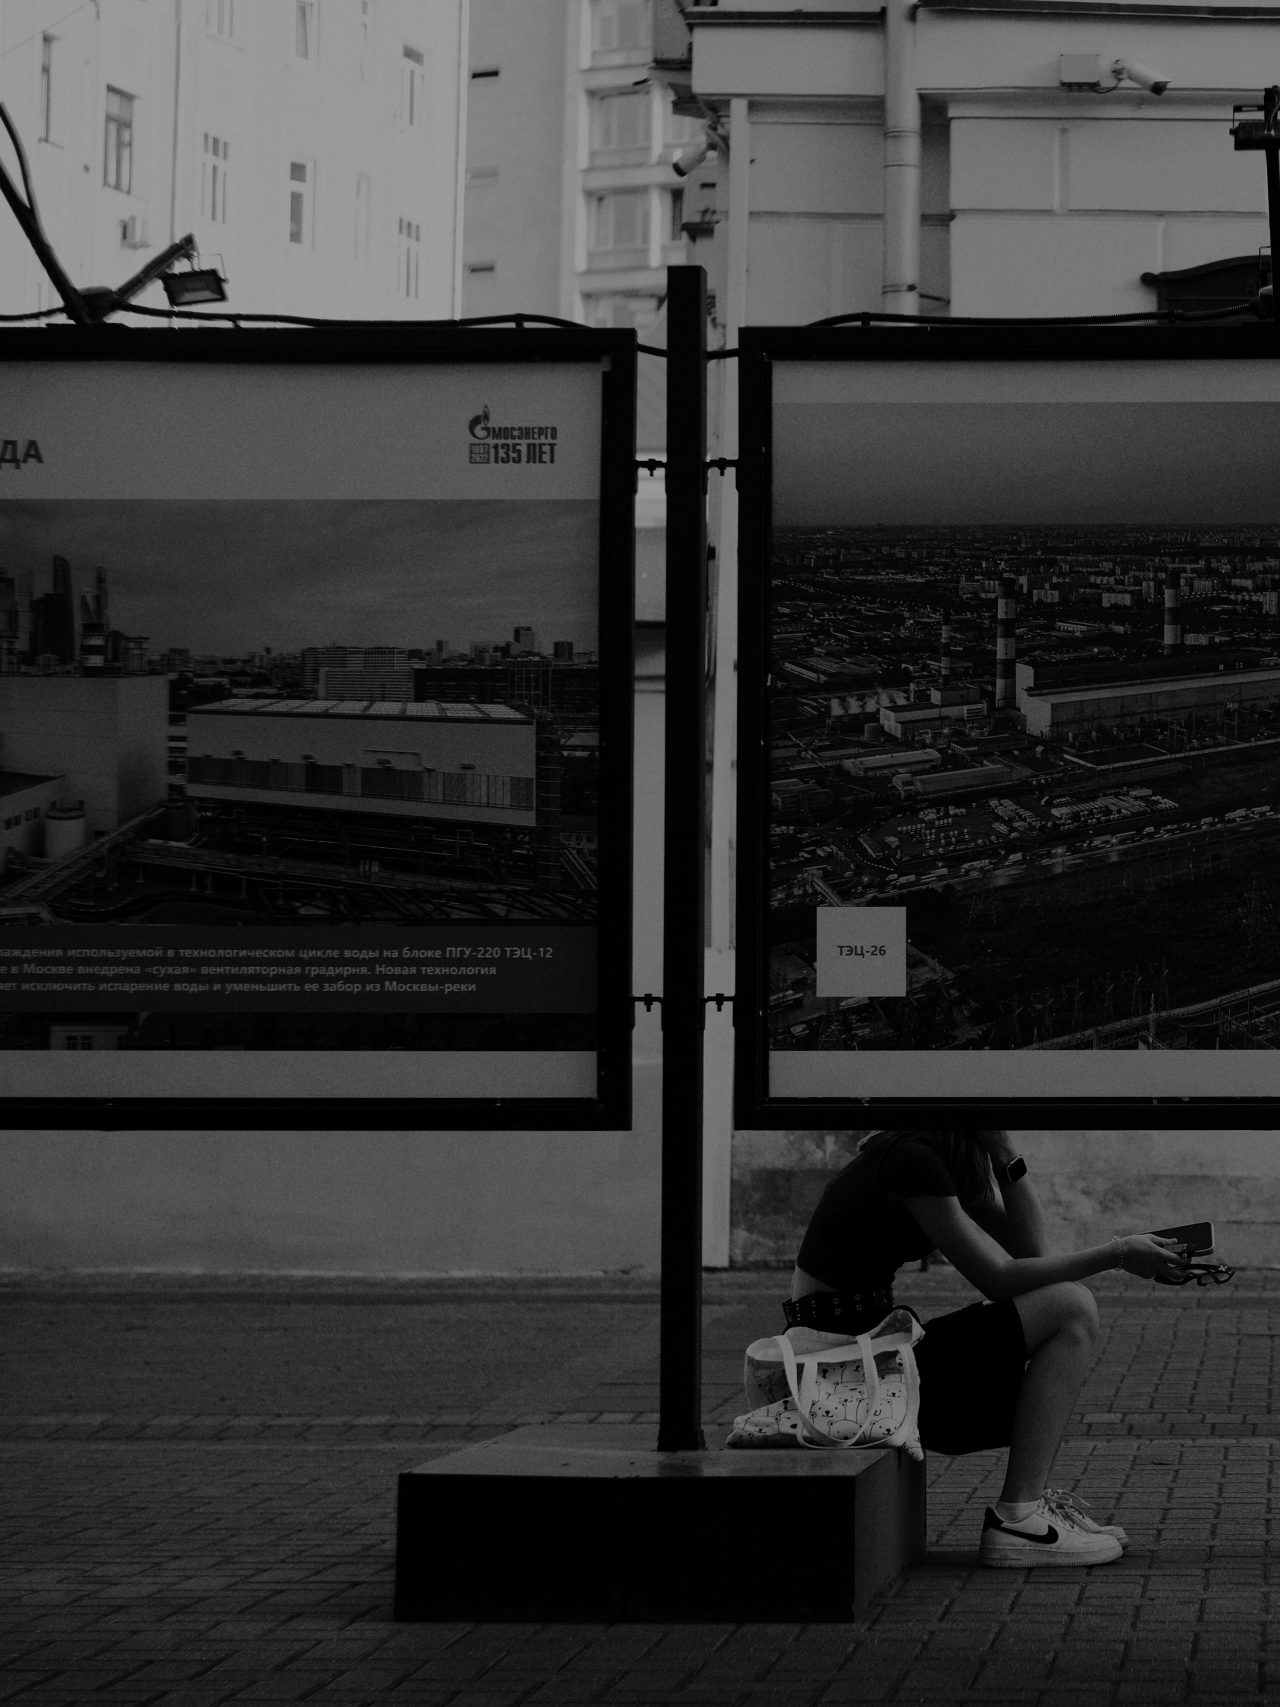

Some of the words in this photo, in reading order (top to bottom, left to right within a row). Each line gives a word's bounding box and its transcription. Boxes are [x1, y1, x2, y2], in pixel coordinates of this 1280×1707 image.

[491, 427, 558, 440] МОСЭНЕРГО
[492, 443, 522, 464] 135
[525, 443, 558, 464] ЛЕТ
[67, 946, 163, 961] используемой
[167, 949, 175, 958] в
[178, 949, 295, 958] технологическом
[299, 949, 340, 960] цикле
[343, 949, 380, 960] воды
[383, 949, 399, 958] на
[402, 946, 443, 959] блоке
[445, 946, 501, 959] ПГУ-220
[503, 946, 553, 961] ТЭЦ-12
[837, 945, 885, 959] ТЭЦ-26
[11, 966, 19, 974] в
[23, 963, 74, 974] Москве
[77, 966, 141, 977] внедрена
[200, 966, 301, 978] вентиляторная
[305, 966, 372, 978] градирня.
[375, 963, 417, 975] Новая
[420, 966, 497, 975] технология
[21, 982, 95, 991] исключить
[98, 982, 170, 993] испарение
[173, 983, 209, 993] воды
[212, 983, 222, 991] и
[225, 983, 301, 994] уменьшить
[303, 983, 320, 992] ее
[322, 980, 362, 994] забор
[365, 983, 381, 992] из
[384, 980, 477, 995] Москвы-реки
